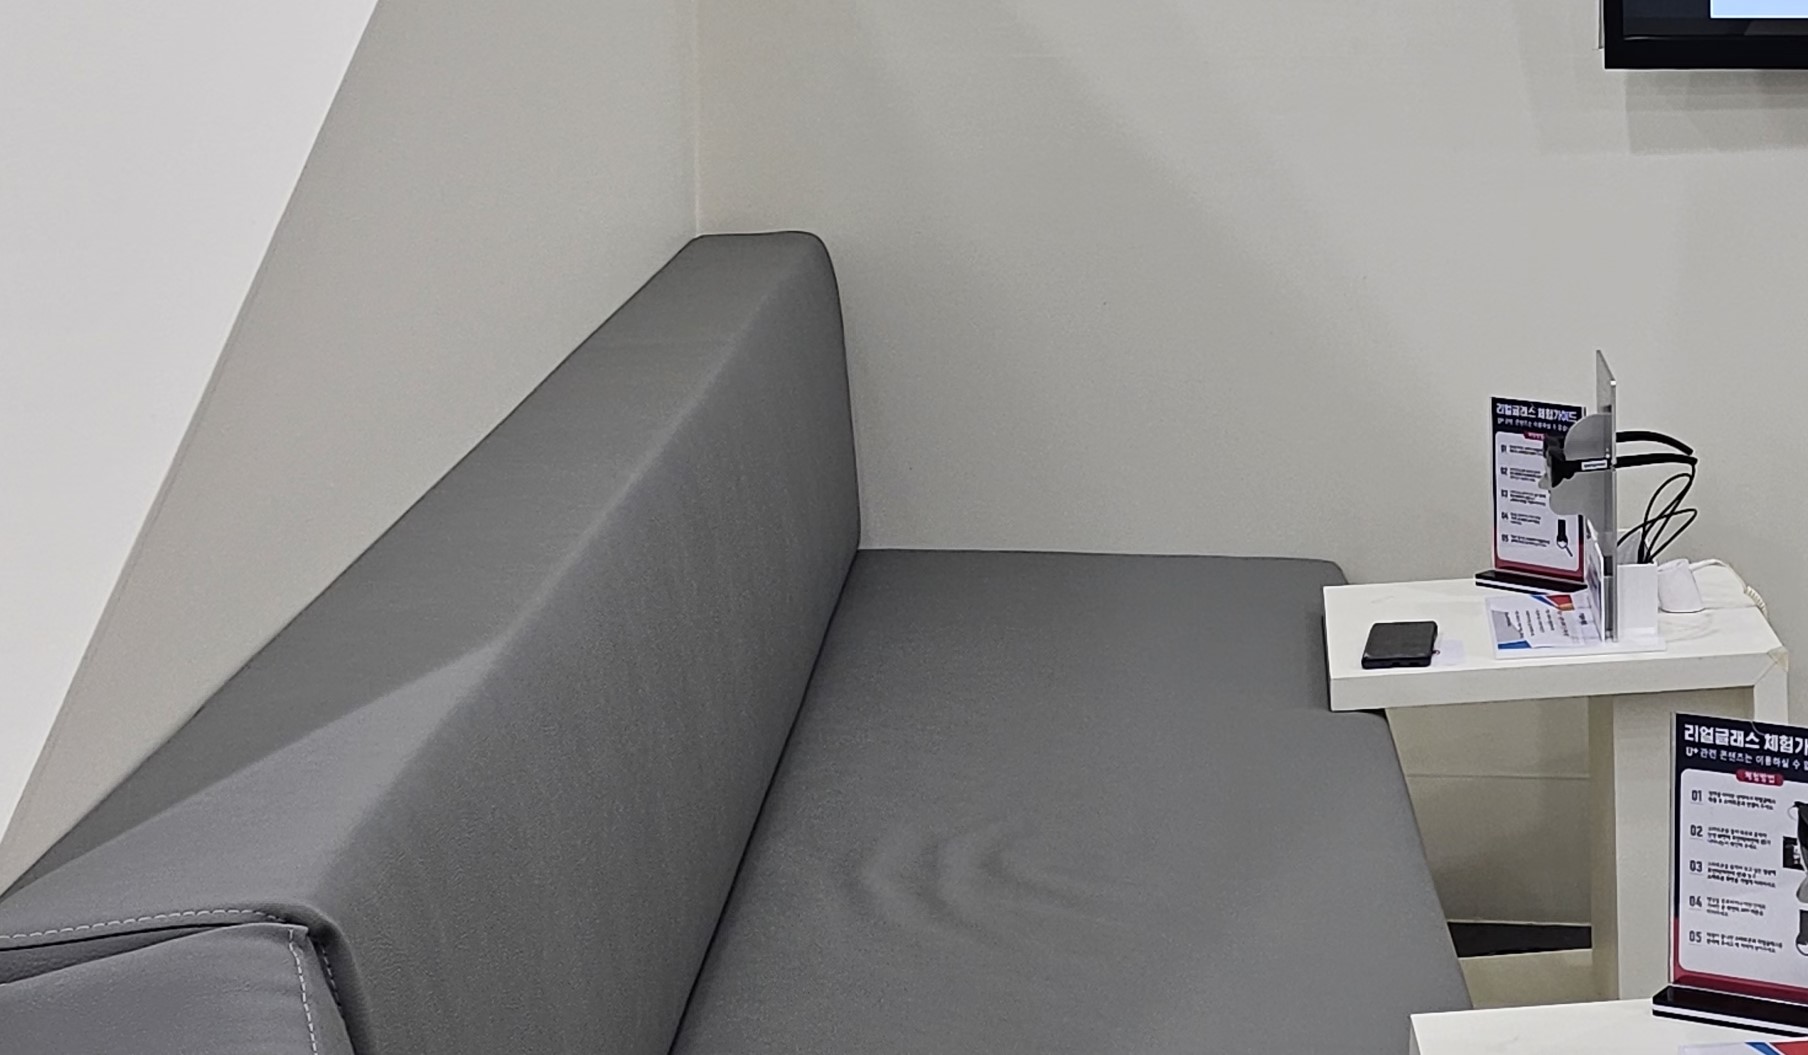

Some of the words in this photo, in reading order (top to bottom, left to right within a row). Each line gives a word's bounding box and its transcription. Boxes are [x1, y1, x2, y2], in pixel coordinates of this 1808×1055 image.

[1684, 723, 1760, 749] 리얼글래스
[1700, 747, 1717, 760] 관련
[1719, 750, 1753, 764] 콘텐츠는
[1756, 755, 1790, 769] 이용하실
[1792, 759, 1801, 770] 수
[1691, 790, 1702, 802] 01
[1690, 824, 1703, 837] 02
[1690, 860, 1703, 872] 03
[1689, 895, 1702, 908] 04
[1689, 930, 1702, 943] 05
